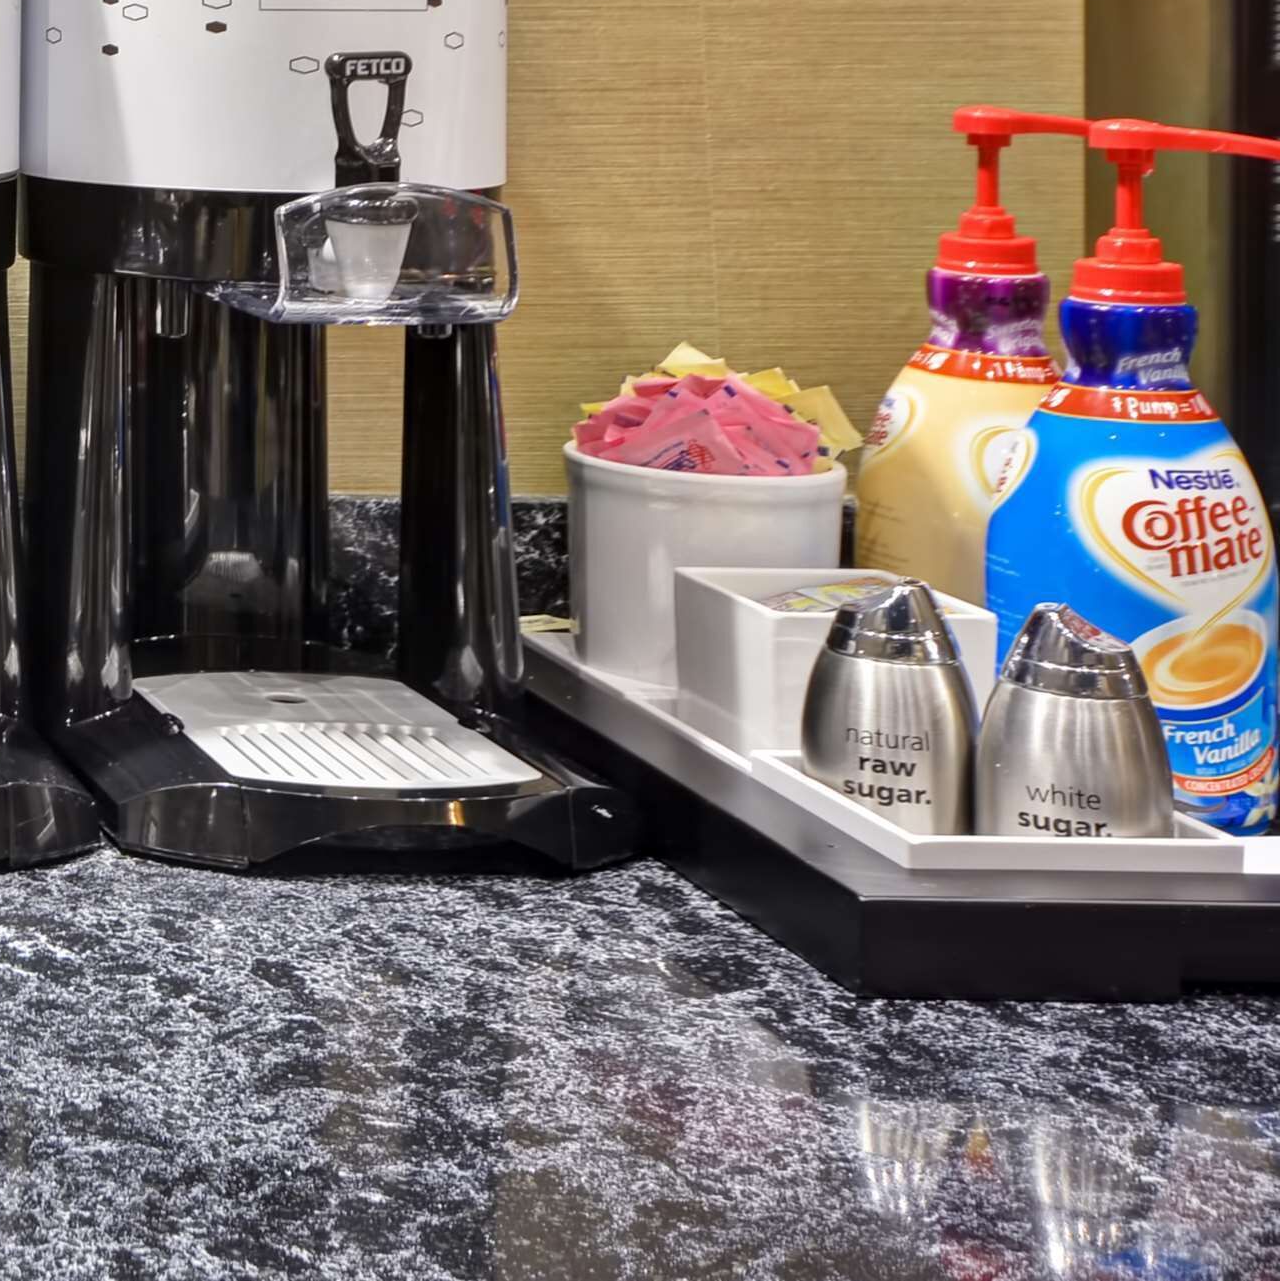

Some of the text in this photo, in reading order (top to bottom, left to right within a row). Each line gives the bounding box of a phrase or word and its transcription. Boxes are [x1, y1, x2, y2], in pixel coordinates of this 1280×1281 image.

[345, 57, 407, 76] FETCO
[1115, 346, 1184, 375] French
[1168, 527, 1263, 578] mate
[845, 726, 930, 752] natural
[1162, 718, 1236, 745] French
[1193, 728, 1261, 765] Vanilla
[858, 755, 917, 777] raw
[843, 778, 932, 807] sugar.
[1026, 783, 1102, 811] white
[1018, 810, 1112, 837] sugar.
